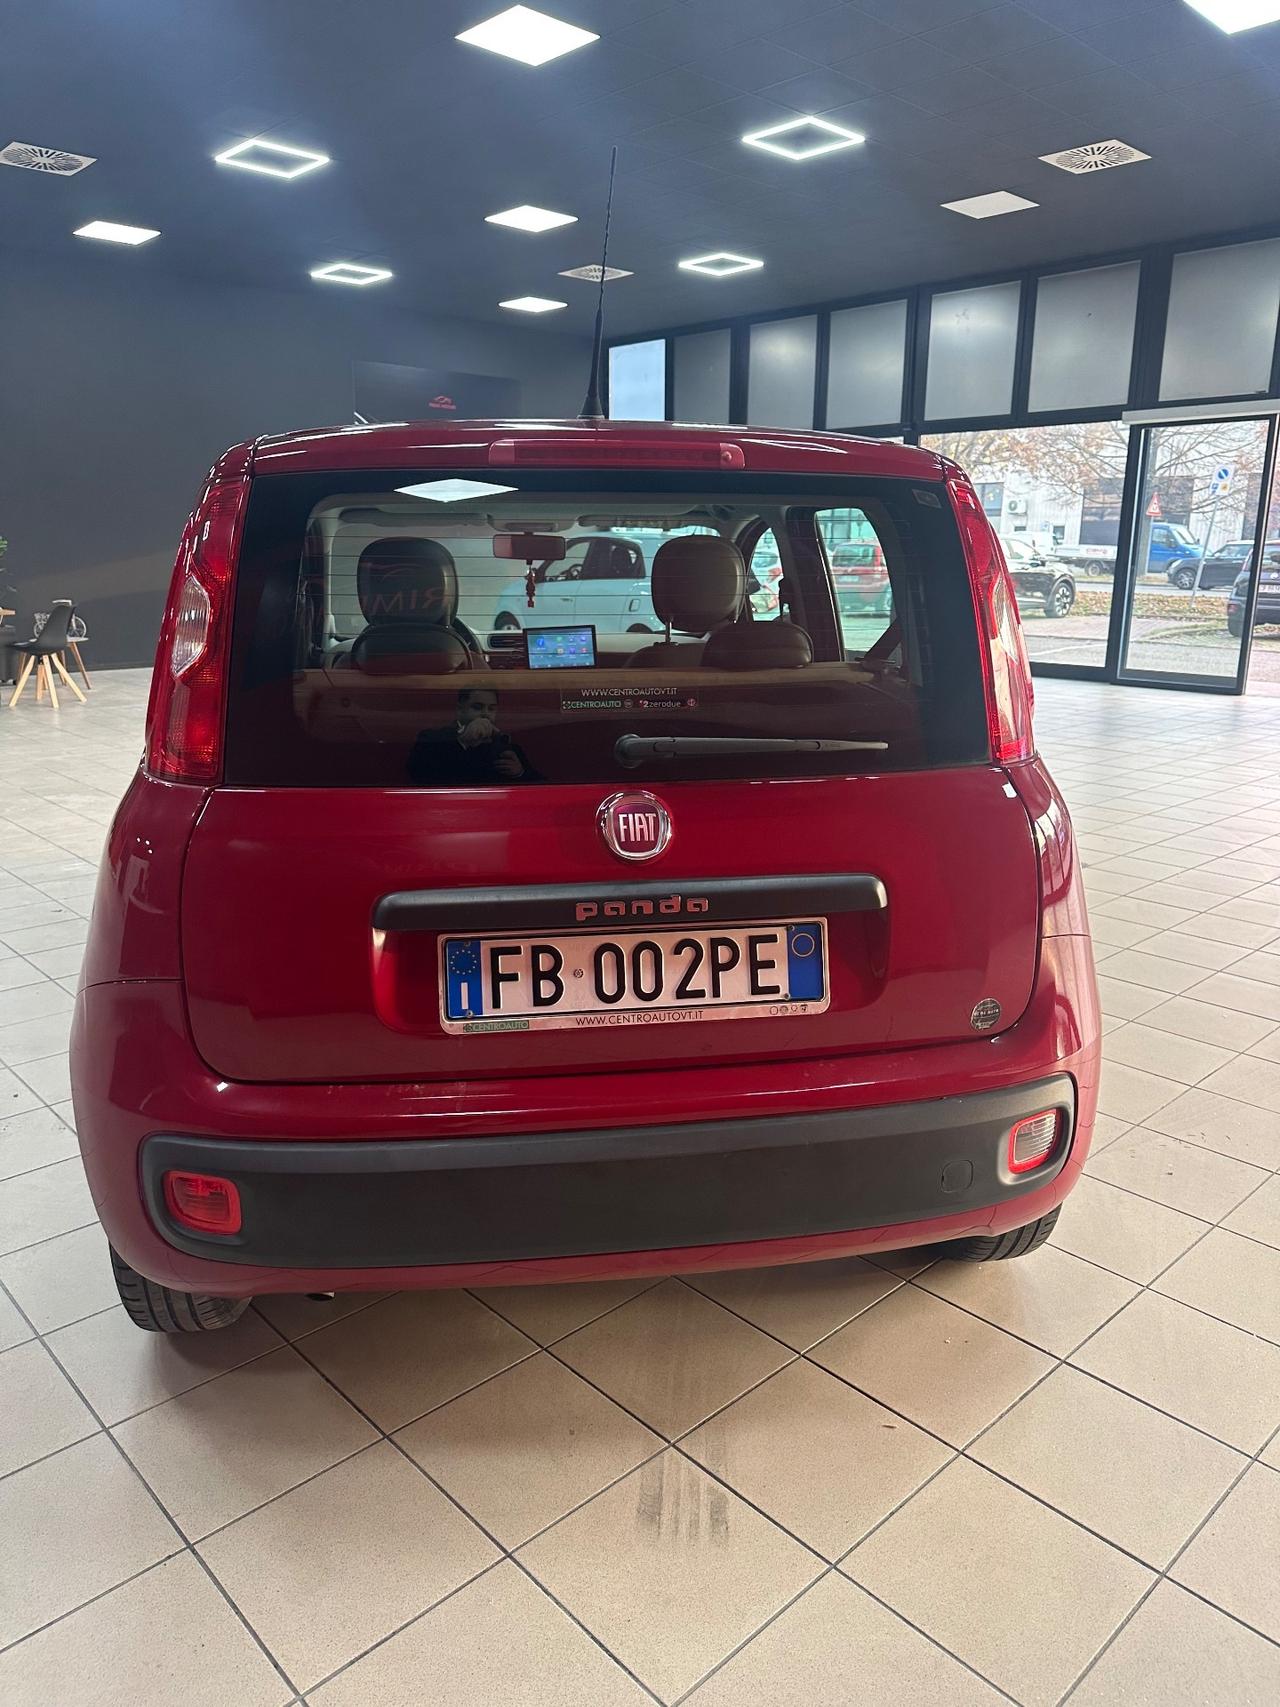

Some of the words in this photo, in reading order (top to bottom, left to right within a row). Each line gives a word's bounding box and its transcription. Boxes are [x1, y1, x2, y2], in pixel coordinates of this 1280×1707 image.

[581, 687, 678, 697] WWW.CENTROAUTOVT.IT
[570, 700, 622, 709] CENTROAUTO
[618, 813, 657, 842] FIAT
[576, 894, 709, 921] panda
[490, 944, 565, 1009] FB
[593, 934, 781, 1004] 002PE
[575, 1010, 704, 1026] WWW.CENTROAUTOVT.IT
[471, 1021, 529, 1032] CENTROAUTO
